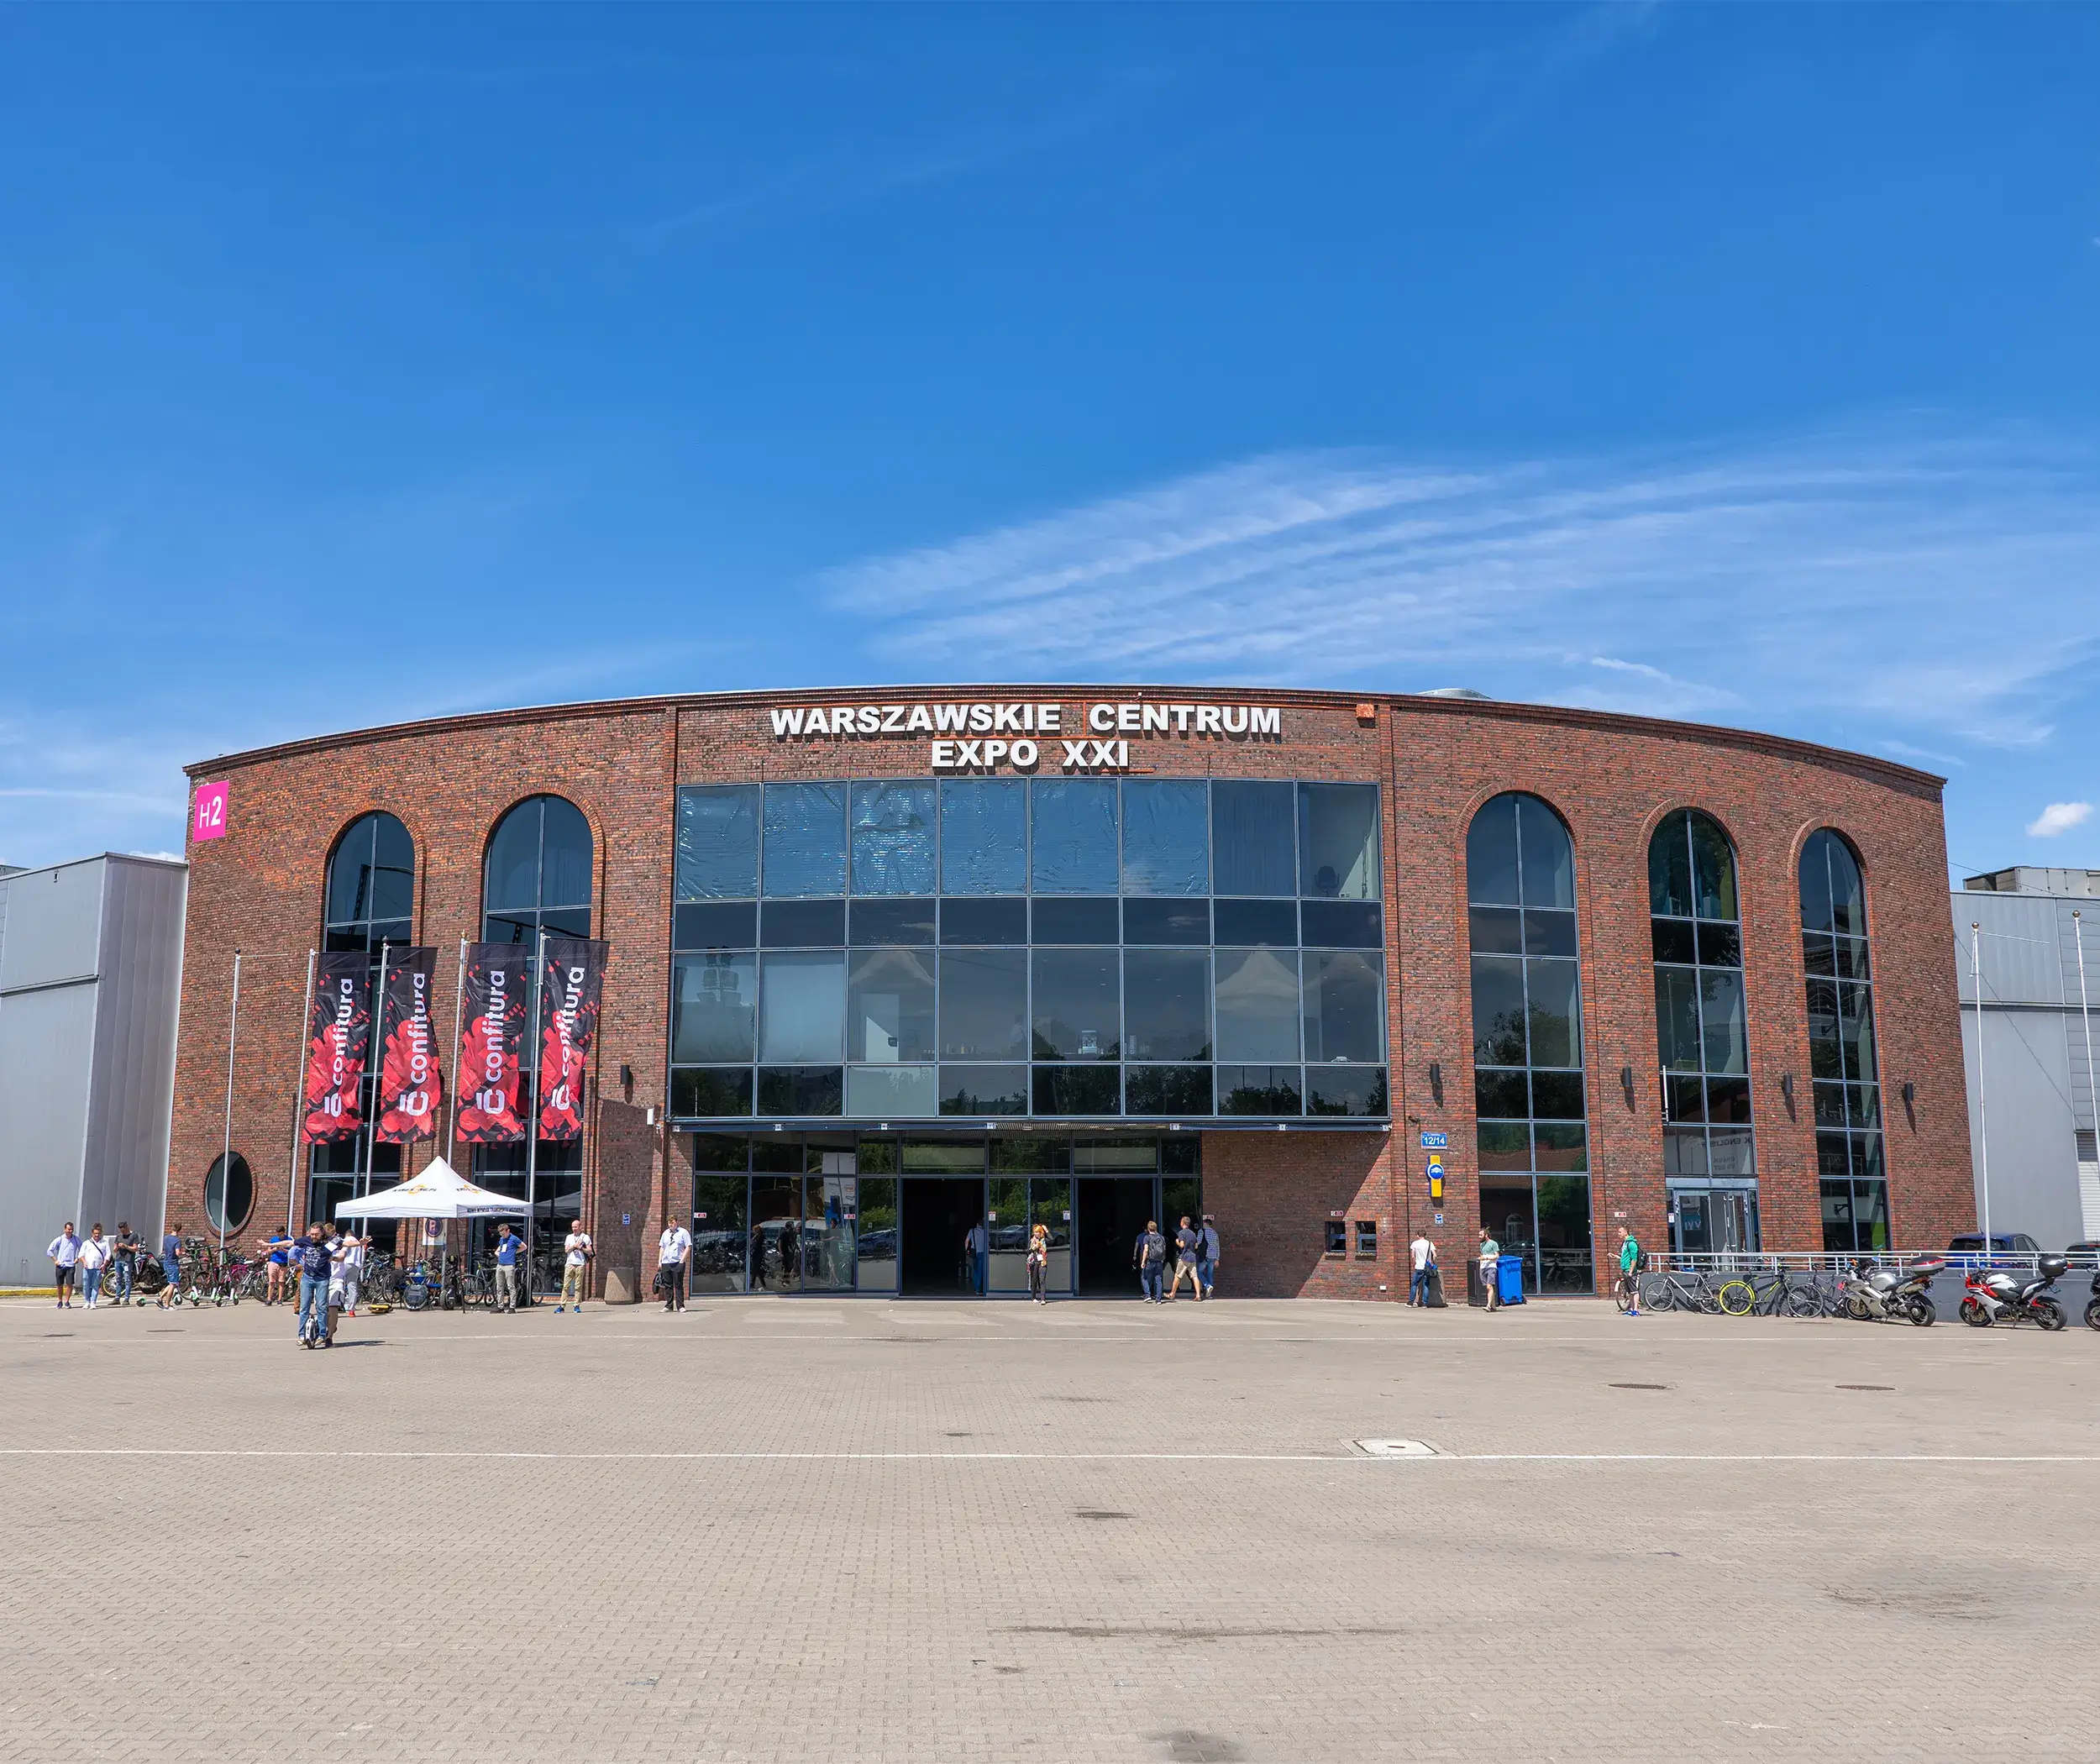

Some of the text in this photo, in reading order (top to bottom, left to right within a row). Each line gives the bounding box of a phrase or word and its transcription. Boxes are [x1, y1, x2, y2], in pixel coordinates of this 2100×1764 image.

[770, 704, 1280, 736] WARSZAWSKIE CENTRUM
[932, 739, 1128, 767] EXPO XXI
[199, 795, 222, 829] H2
[333, 979, 353, 1086] confitura
[407, 973, 428, 1084] confitura
[482, 970, 505, 1082] confitura
[556, 967, 585, 1077] confitura
[1424, 1137, 1445, 1145] 12/14
